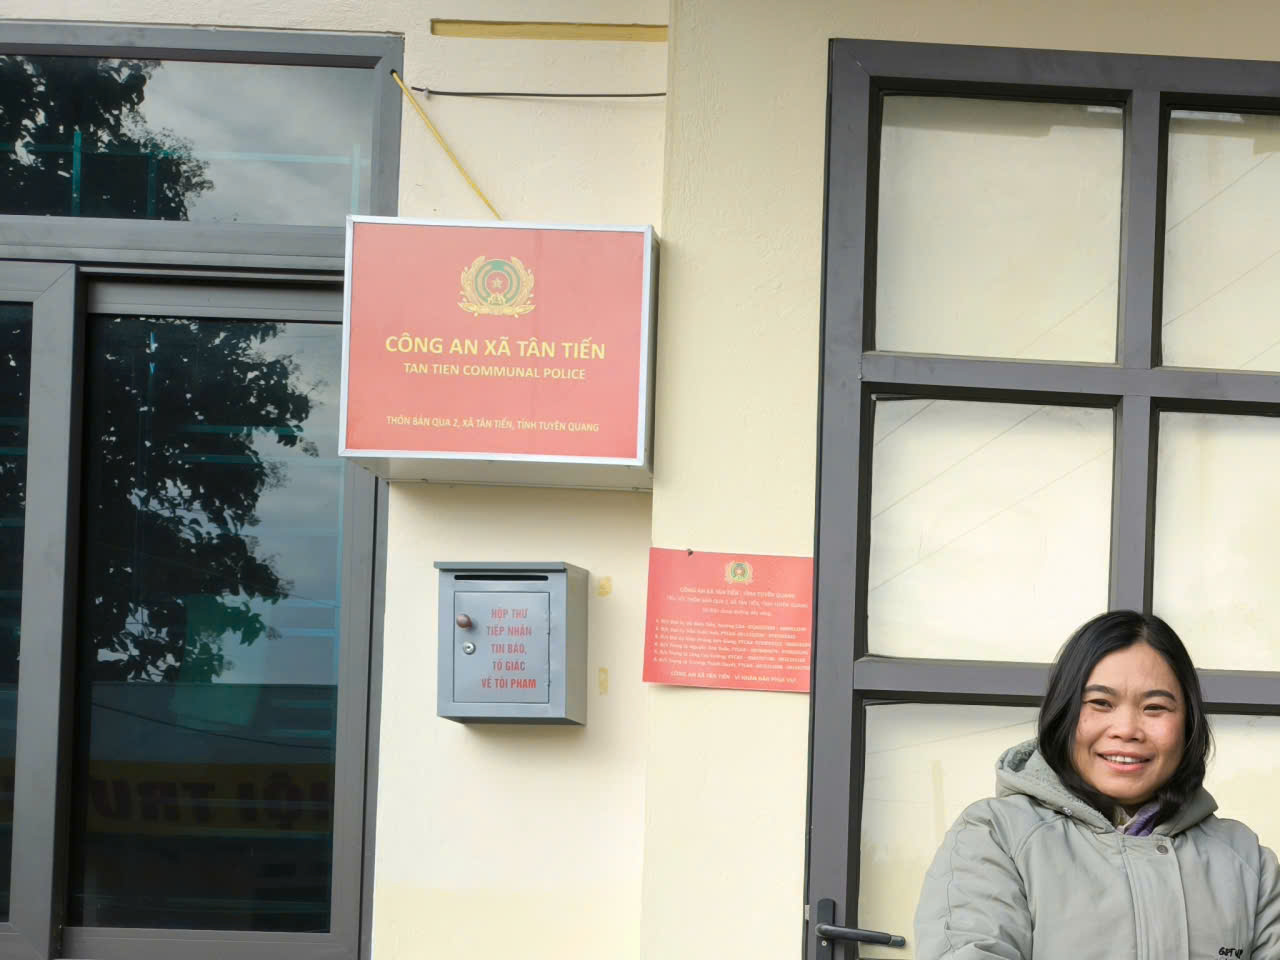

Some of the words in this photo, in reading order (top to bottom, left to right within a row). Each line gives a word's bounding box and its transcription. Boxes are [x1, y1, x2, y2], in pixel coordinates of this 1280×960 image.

[385, 331, 443, 354] CÔNG
[449, 338, 478, 355] AN
[484, 335, 511, 357] XÃ
[516, 336, 556, 358] TÂN
[561, 336, 606, 360] TIẾN
[403, 362, 428, 375] TAN
[432, 363, 460, 376] TIEN
[463, 364, 541, 379] COMMUNAL
[543, 367, 586, 380] POLICE
[386, 414, 411, 425] THÔN
[538, 419, 566, 432] TUYÊN
[568, 422, 600, 433] QUANG
